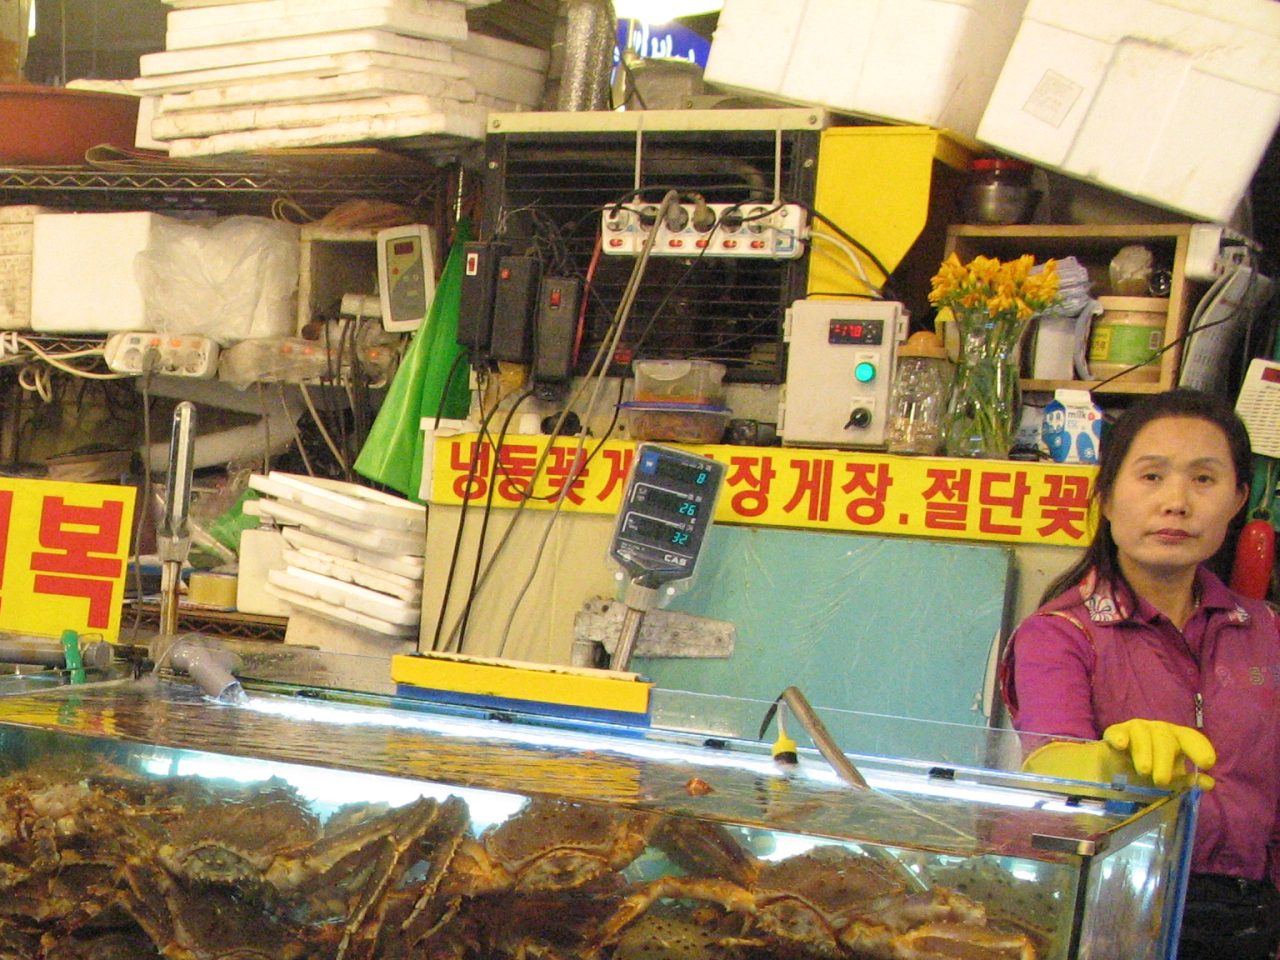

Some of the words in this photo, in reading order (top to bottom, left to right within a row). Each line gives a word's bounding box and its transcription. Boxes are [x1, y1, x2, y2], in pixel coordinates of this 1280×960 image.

[696, 473, 707, 484] 8
[679, 502, 696, 516] 26
[671, 531, 688, 545] 32
[663, 553, 687, 567] CAS
